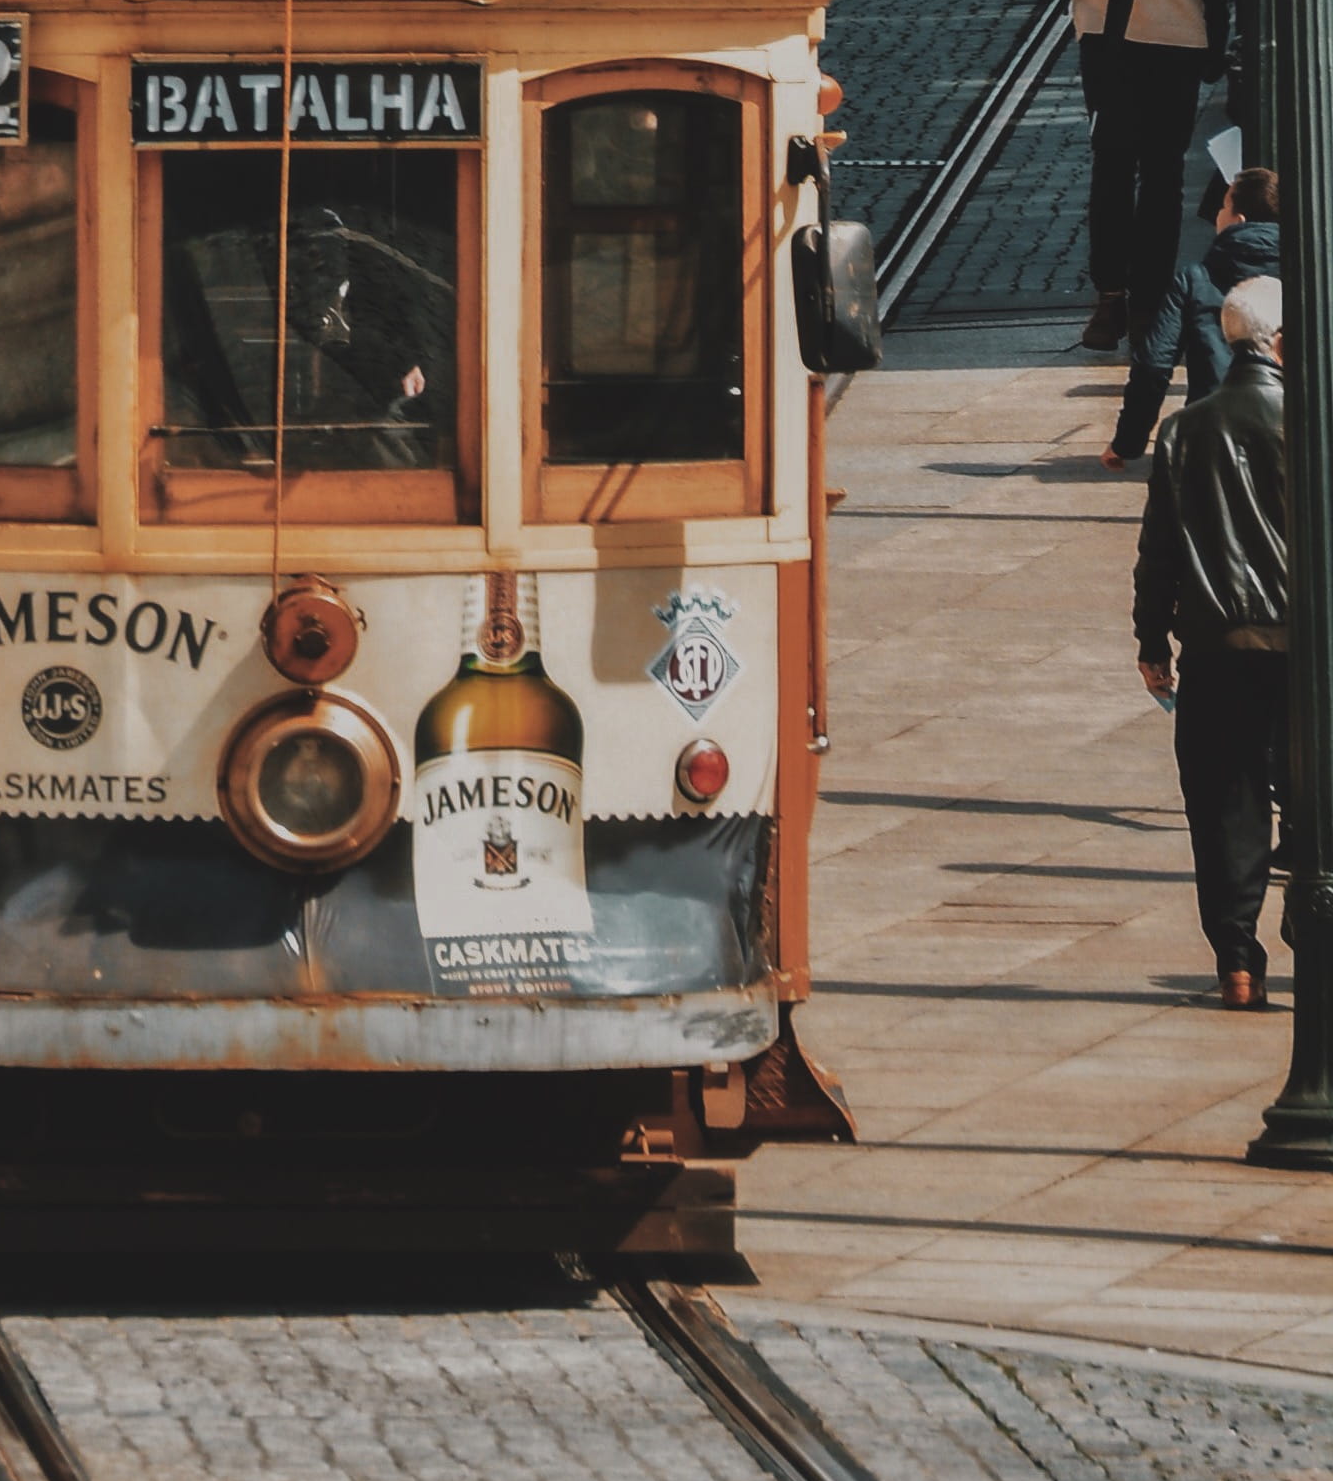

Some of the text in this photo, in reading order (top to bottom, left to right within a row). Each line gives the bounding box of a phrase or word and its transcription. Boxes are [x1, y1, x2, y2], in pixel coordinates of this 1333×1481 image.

[146, 73, 465, 132] BATALHA
[423, 776, 576, 826] JAMESON
[435, 938, 591, 967] CASKMATES
